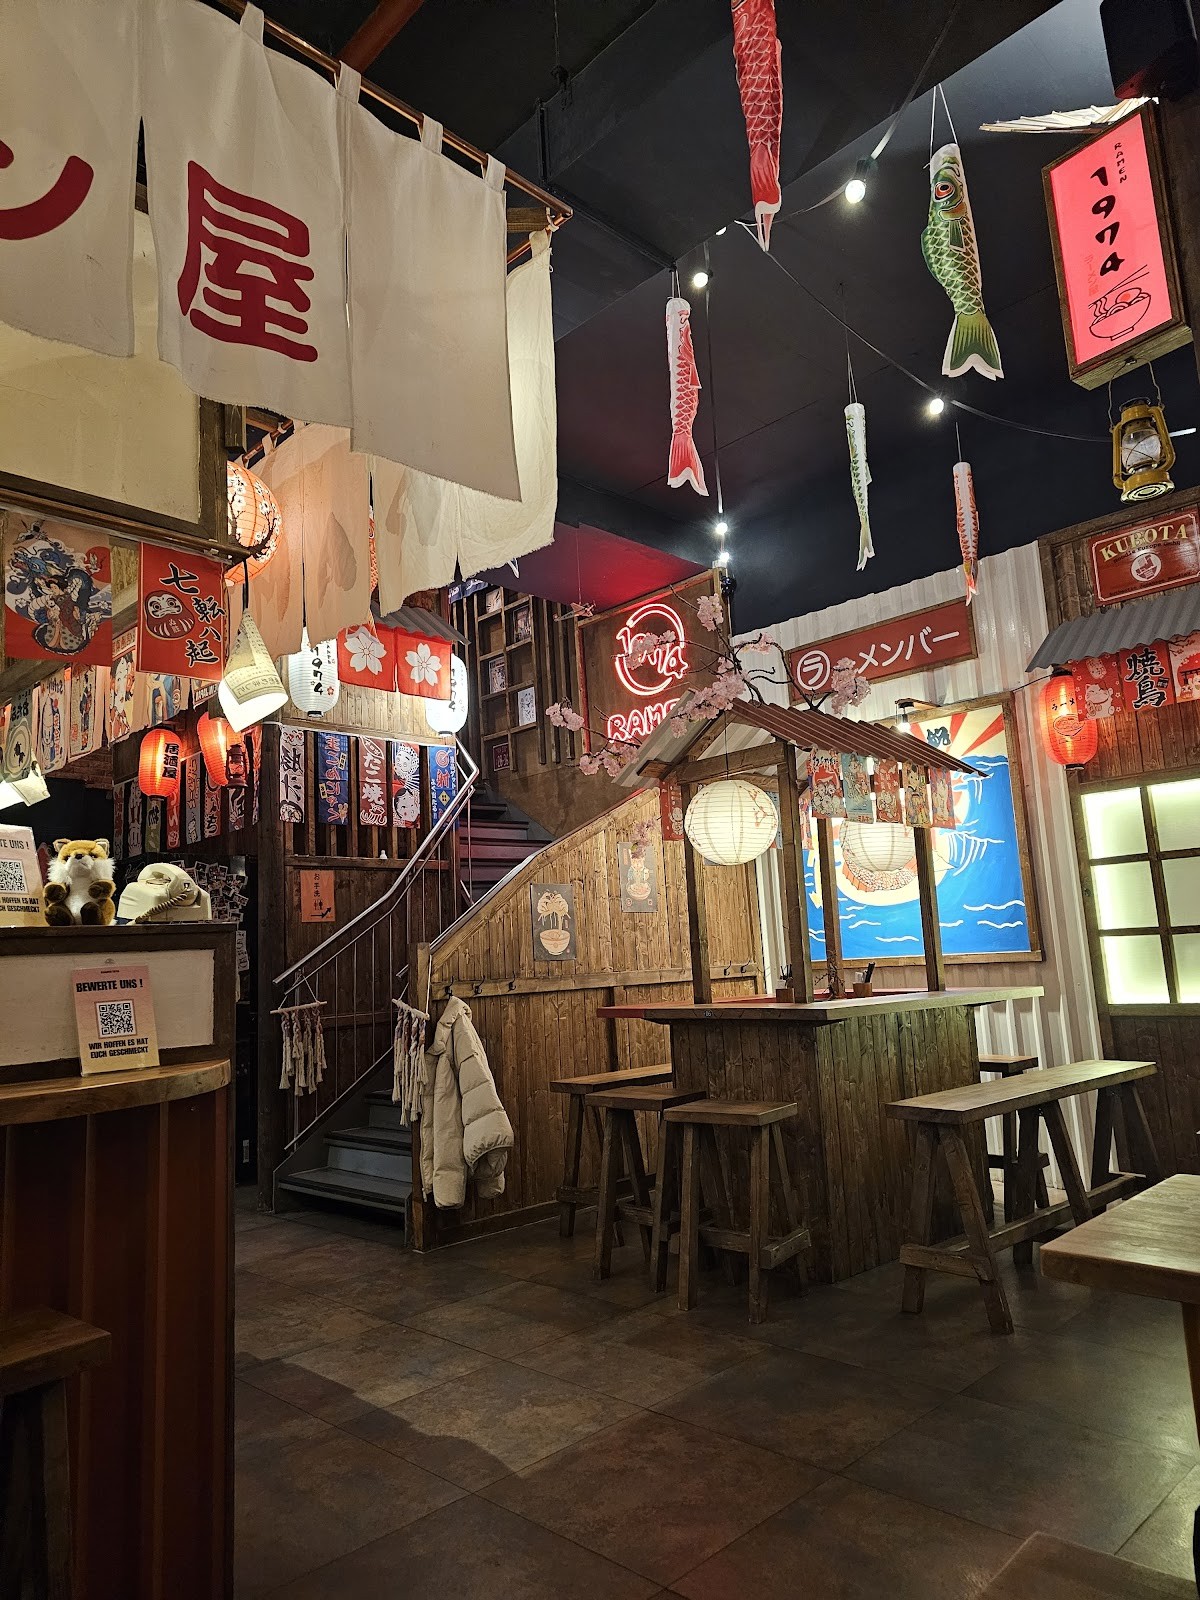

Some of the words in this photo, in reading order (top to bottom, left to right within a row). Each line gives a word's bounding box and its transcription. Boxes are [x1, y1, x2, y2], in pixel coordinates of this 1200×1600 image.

[1114, 142, 1127, 184] RAMEN
[1090, 166, 1125, 277] 1974
[177, 160, 318, 363] 屋
[1099, 523, 1188, 562] KUBOTA
[159, 562, 226, 668] 七転八起
[310, 646, 324, 695] 1974
[1125, 647, 1167, 709] 焼鳥
[162, 743, 180, 779] 居酒屋
[361, 752, 385, 805] たこ焼
[9, 839, 25, 850] UNS
[7, 905, 40, 913] GESCHMECKT
[21, 897, 29, 905] ES
[28, 897, 39, 905] HAT
[76, 980, 118, 993] BEWERTE
[120, 979, 137, 989] UNS
[139, 978, 144, 988] !
[88, 1042, 102, 1050] WIR
[103, 1040, 126, 1049] HOFFEN
[127, 1038, 135, 1046] ES
[136, 1037, 149, 1045] HAT
[90, 1050, 107, 1059] EUCH
[108, 1046, 149, 1057] GESCHMECKT
